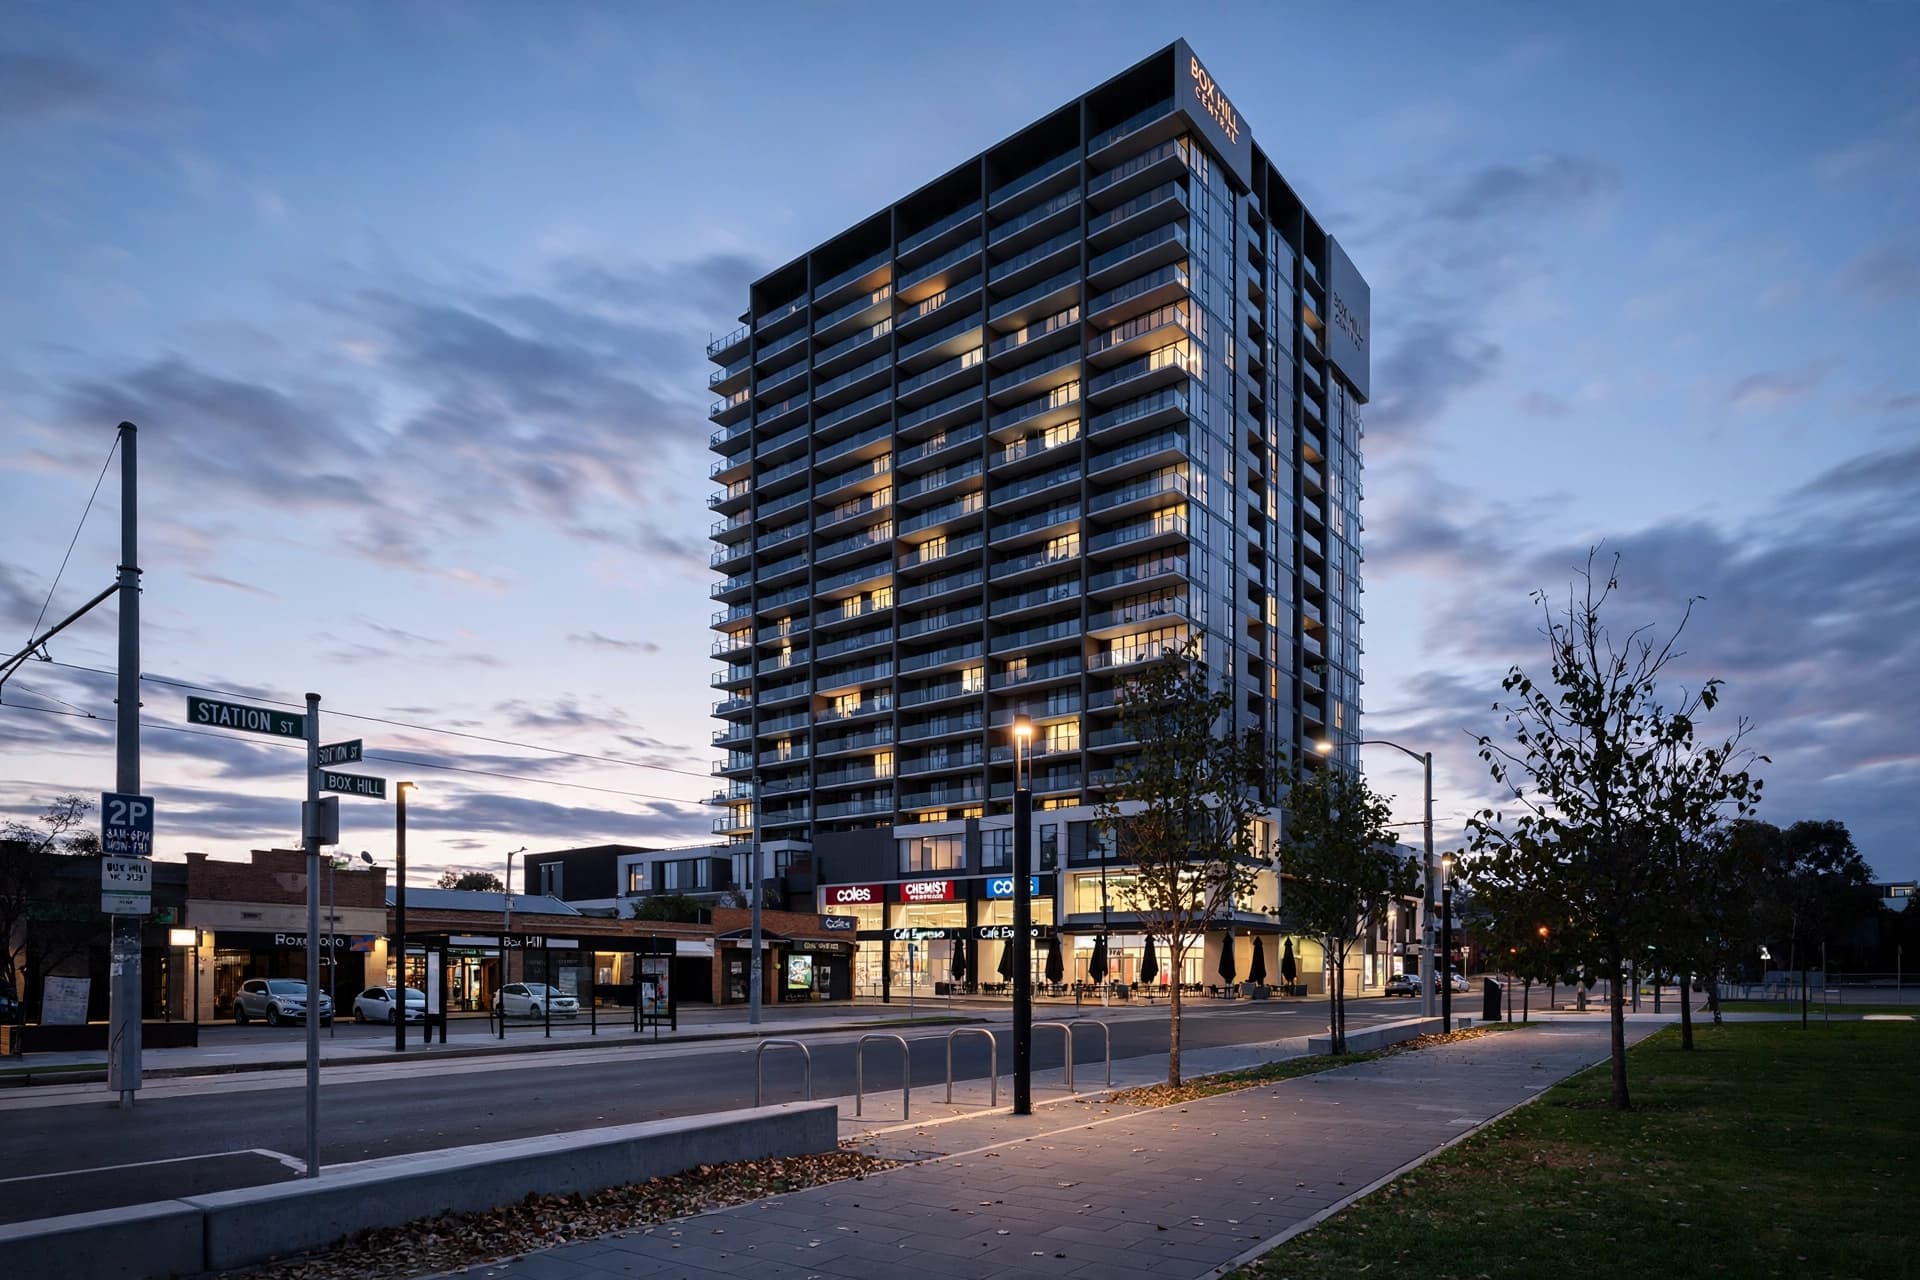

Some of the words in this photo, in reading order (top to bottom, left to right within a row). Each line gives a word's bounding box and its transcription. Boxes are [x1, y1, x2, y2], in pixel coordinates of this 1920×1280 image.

[1191, 56, 1215, 102] BOX
[1217, 92, 1240, 135] HILL
[198, 701, 271, 732] STATION
[280, 720, 294, 735] ST
[329, 775, 352, 791] BOX
[357, 779, 383, 795] HILL
[108, 799, 148, 826] 2P
[837, 886, 871, 902] coles
[905, 881, 948, 895] CHEMIST
